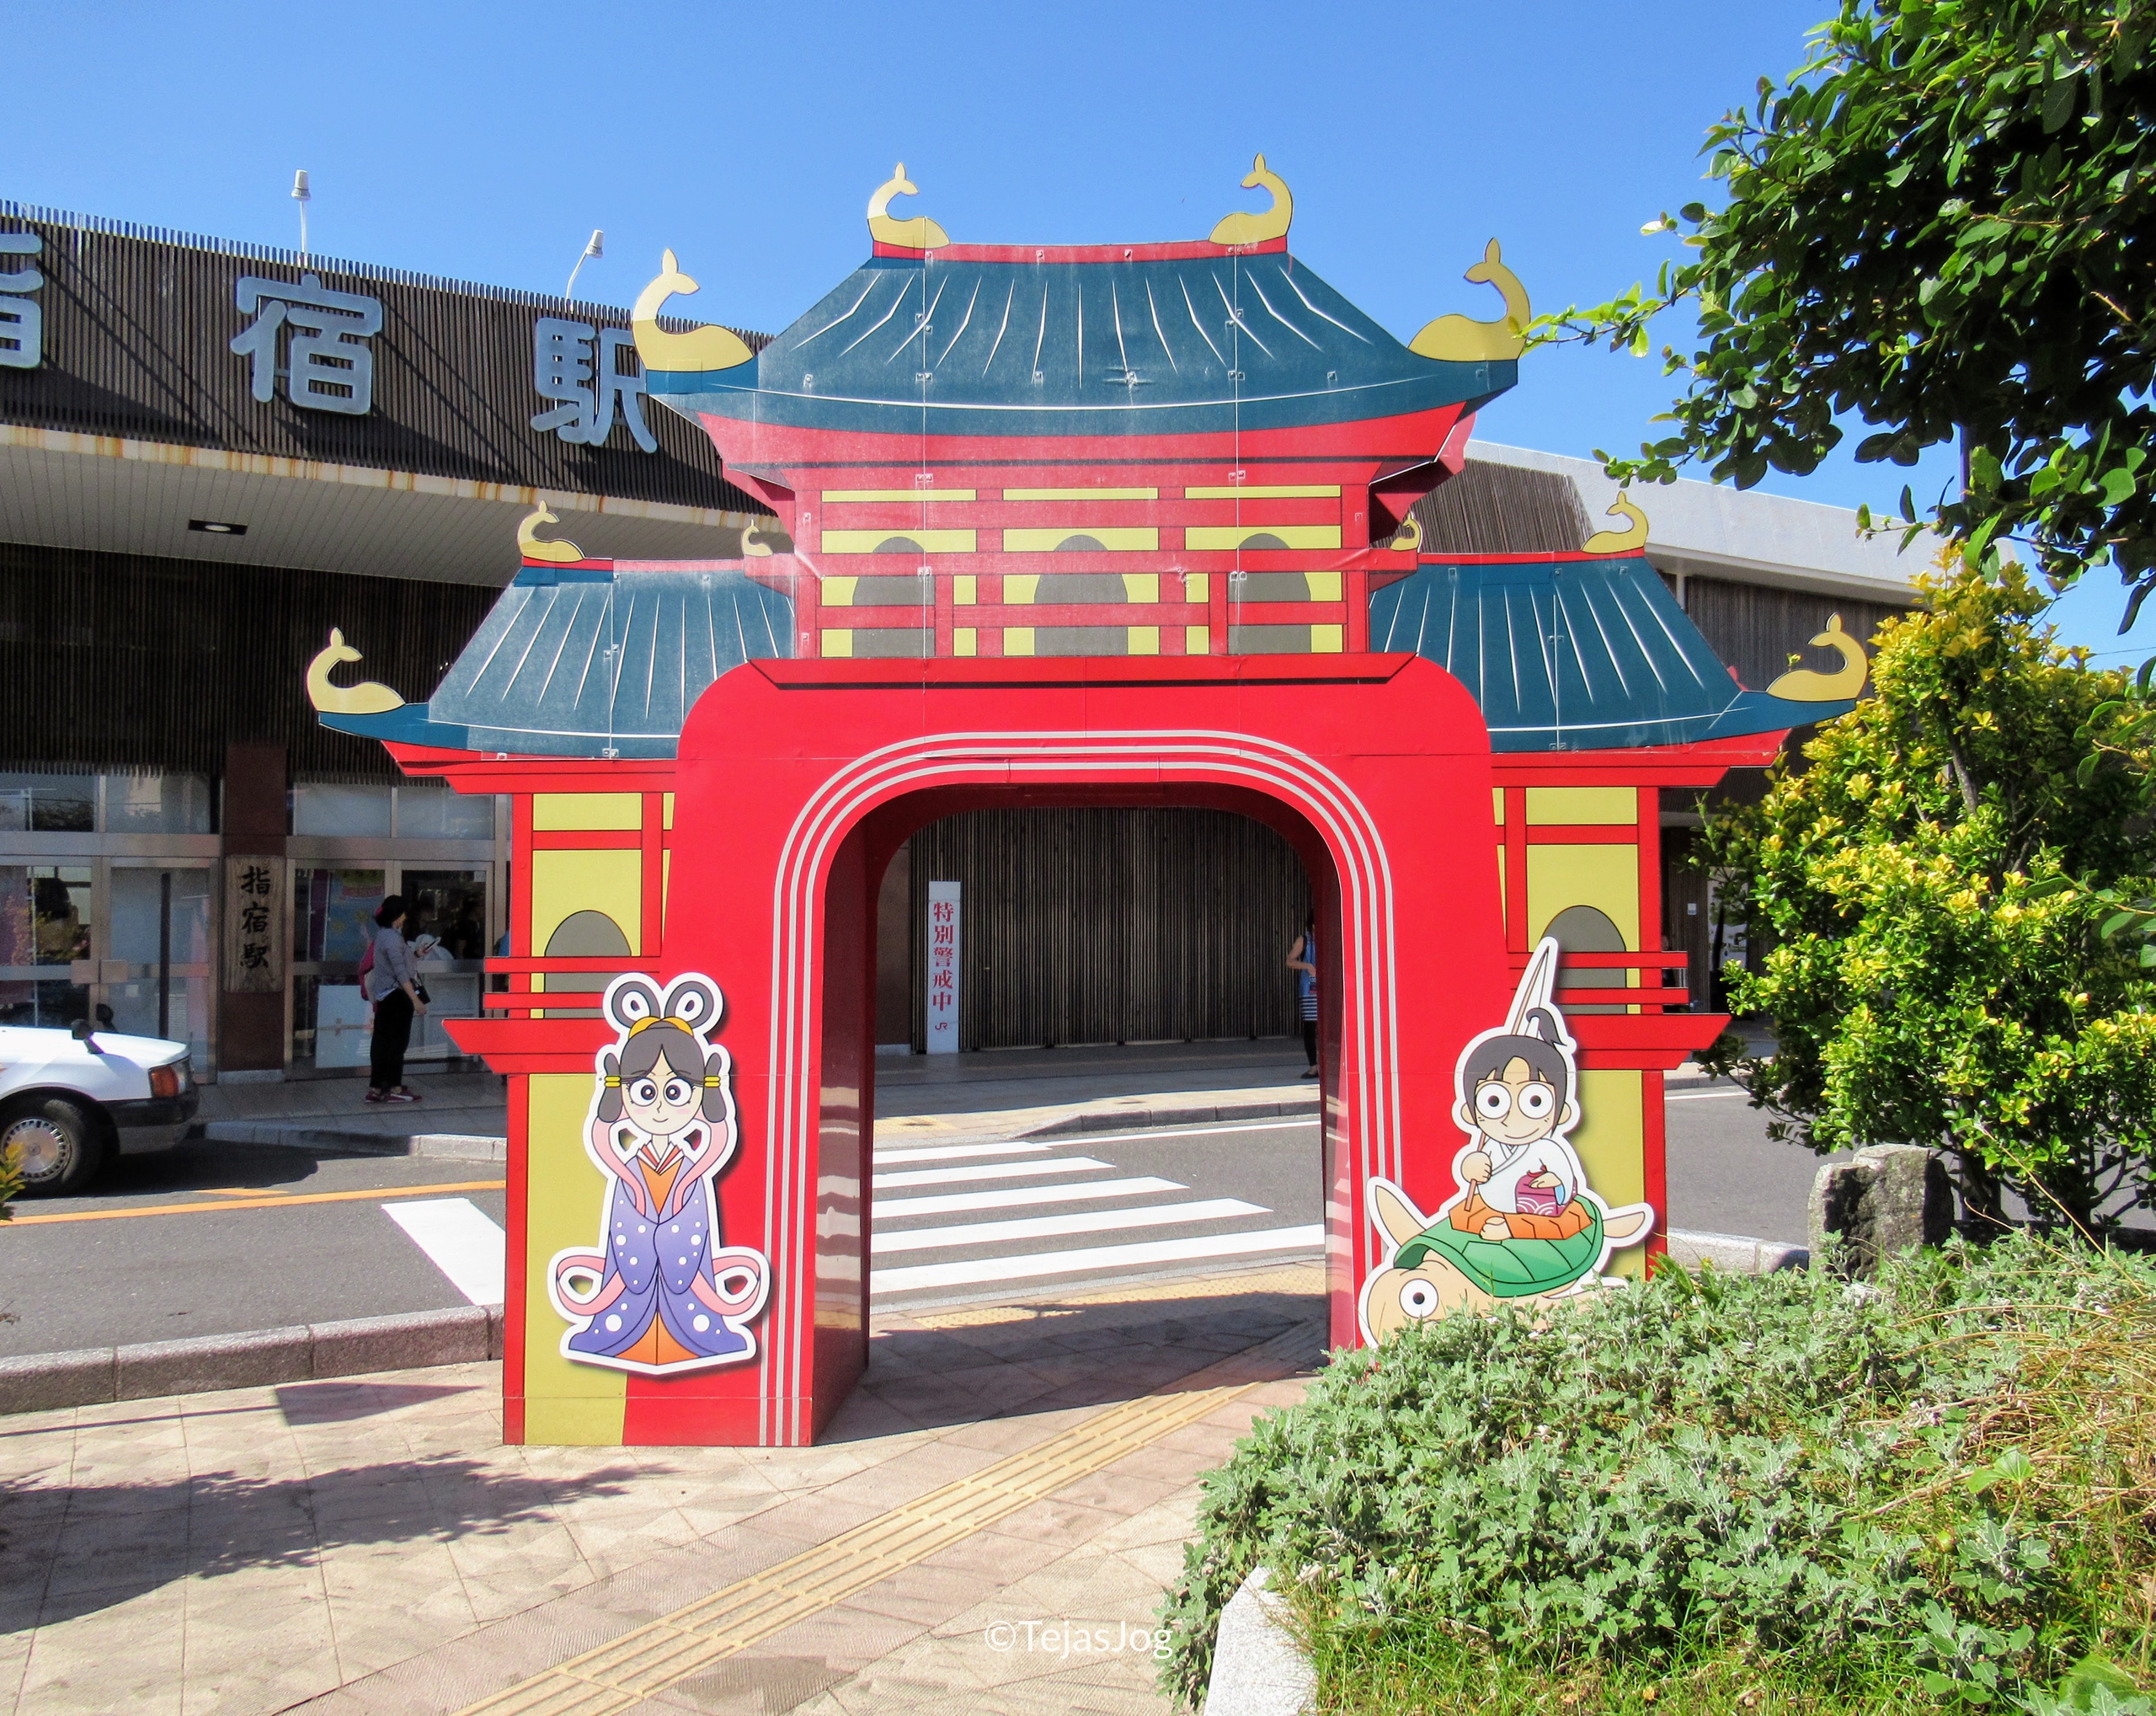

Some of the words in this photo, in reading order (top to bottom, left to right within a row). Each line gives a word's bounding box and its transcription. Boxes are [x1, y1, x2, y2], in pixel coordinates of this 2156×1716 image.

[240, 865, 270, 969] 指宿駅
[932, 902, 954, 1011] 特別警戒中
[935, 1022, 947, 1030] JR
